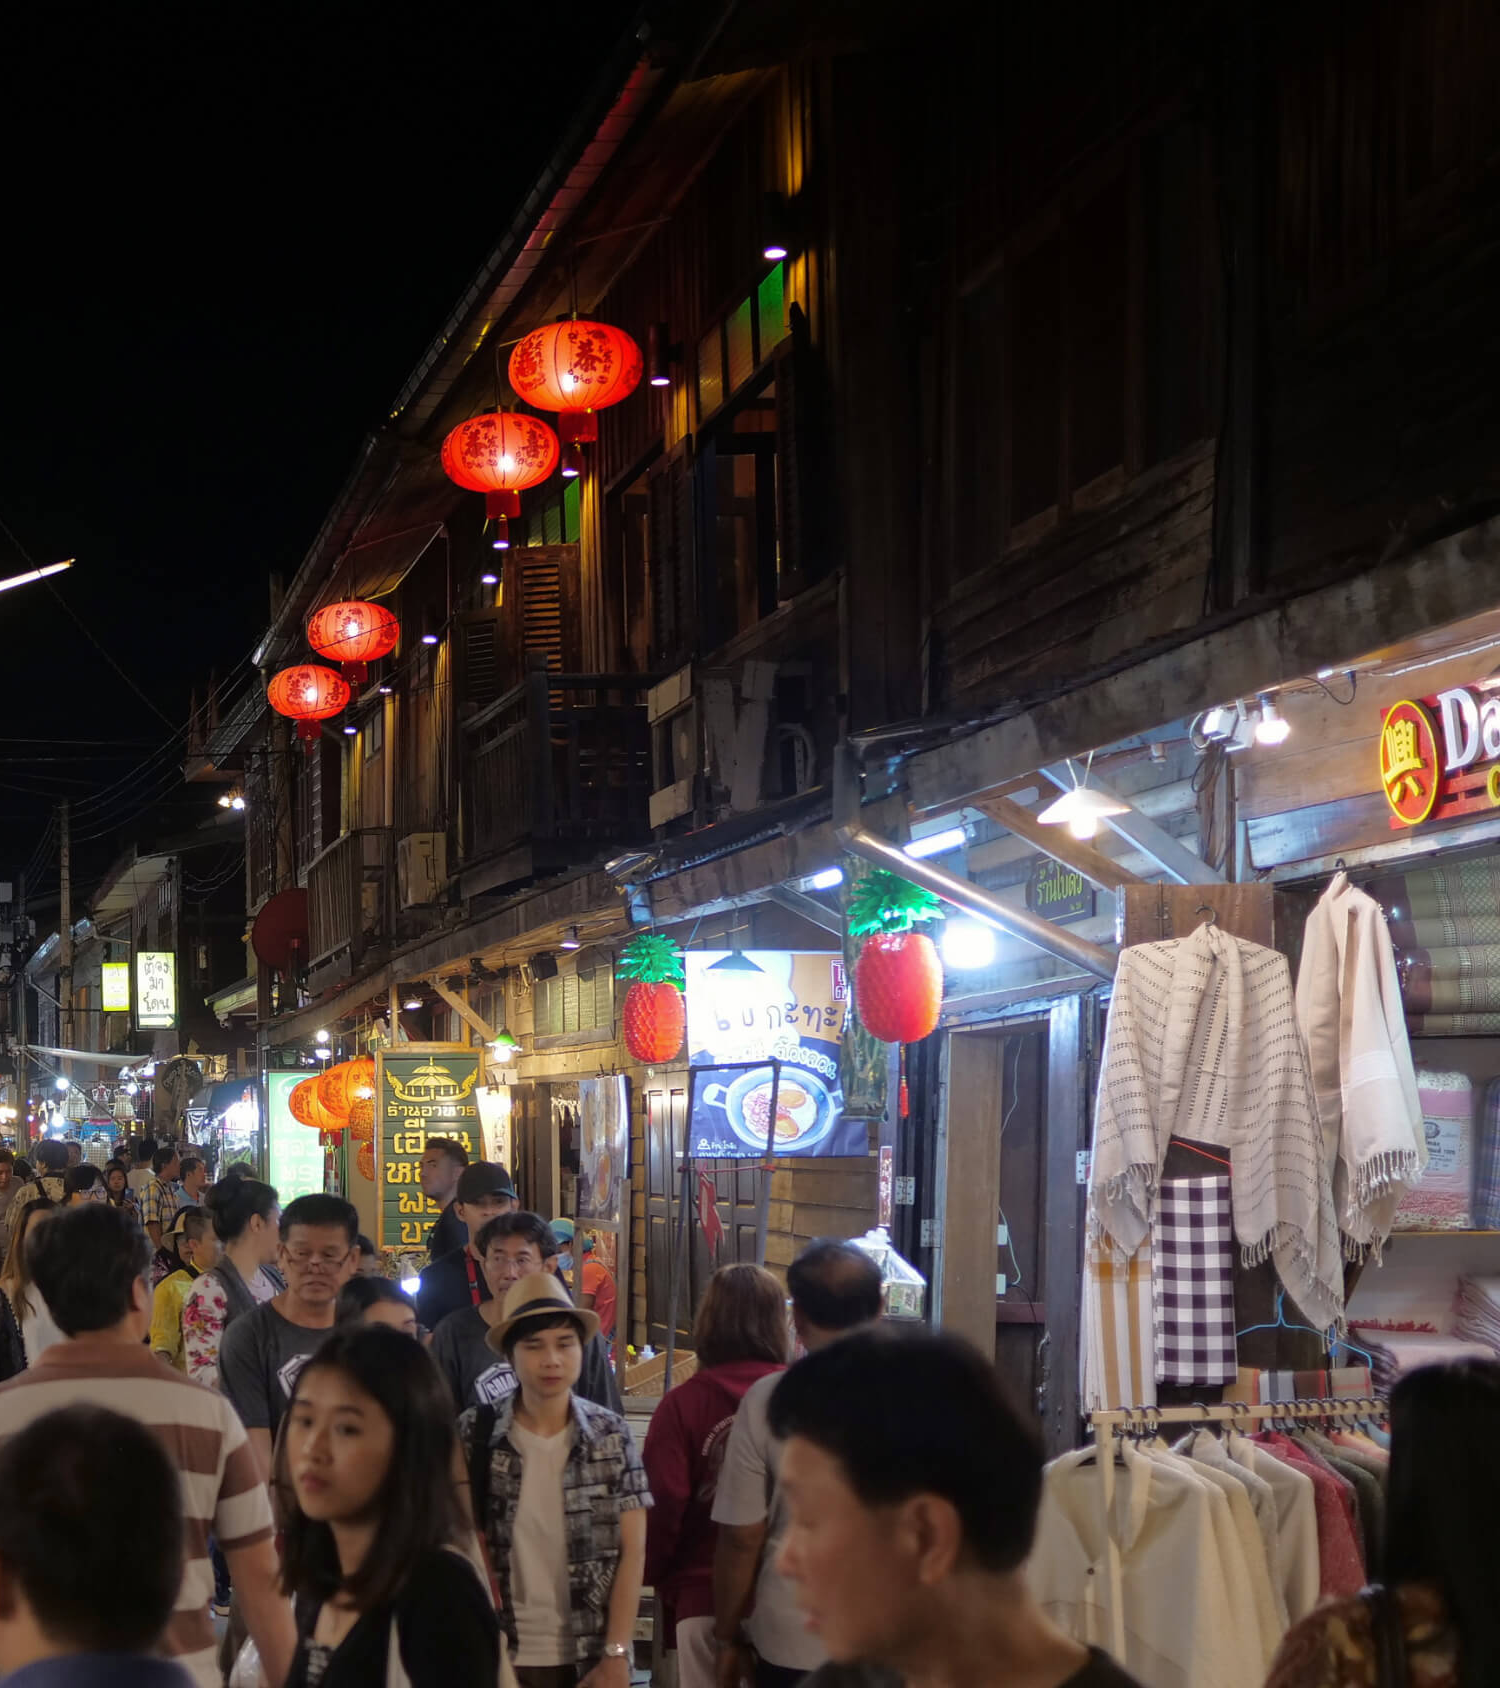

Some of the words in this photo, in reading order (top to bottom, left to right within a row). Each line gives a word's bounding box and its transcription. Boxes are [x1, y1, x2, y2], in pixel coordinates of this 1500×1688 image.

[387, 1101, 477, 1117] ร้านอาหาร
[393, 1118, 472, 1154] เฮืน
[485, 1372, 517, 1397] CHIA
